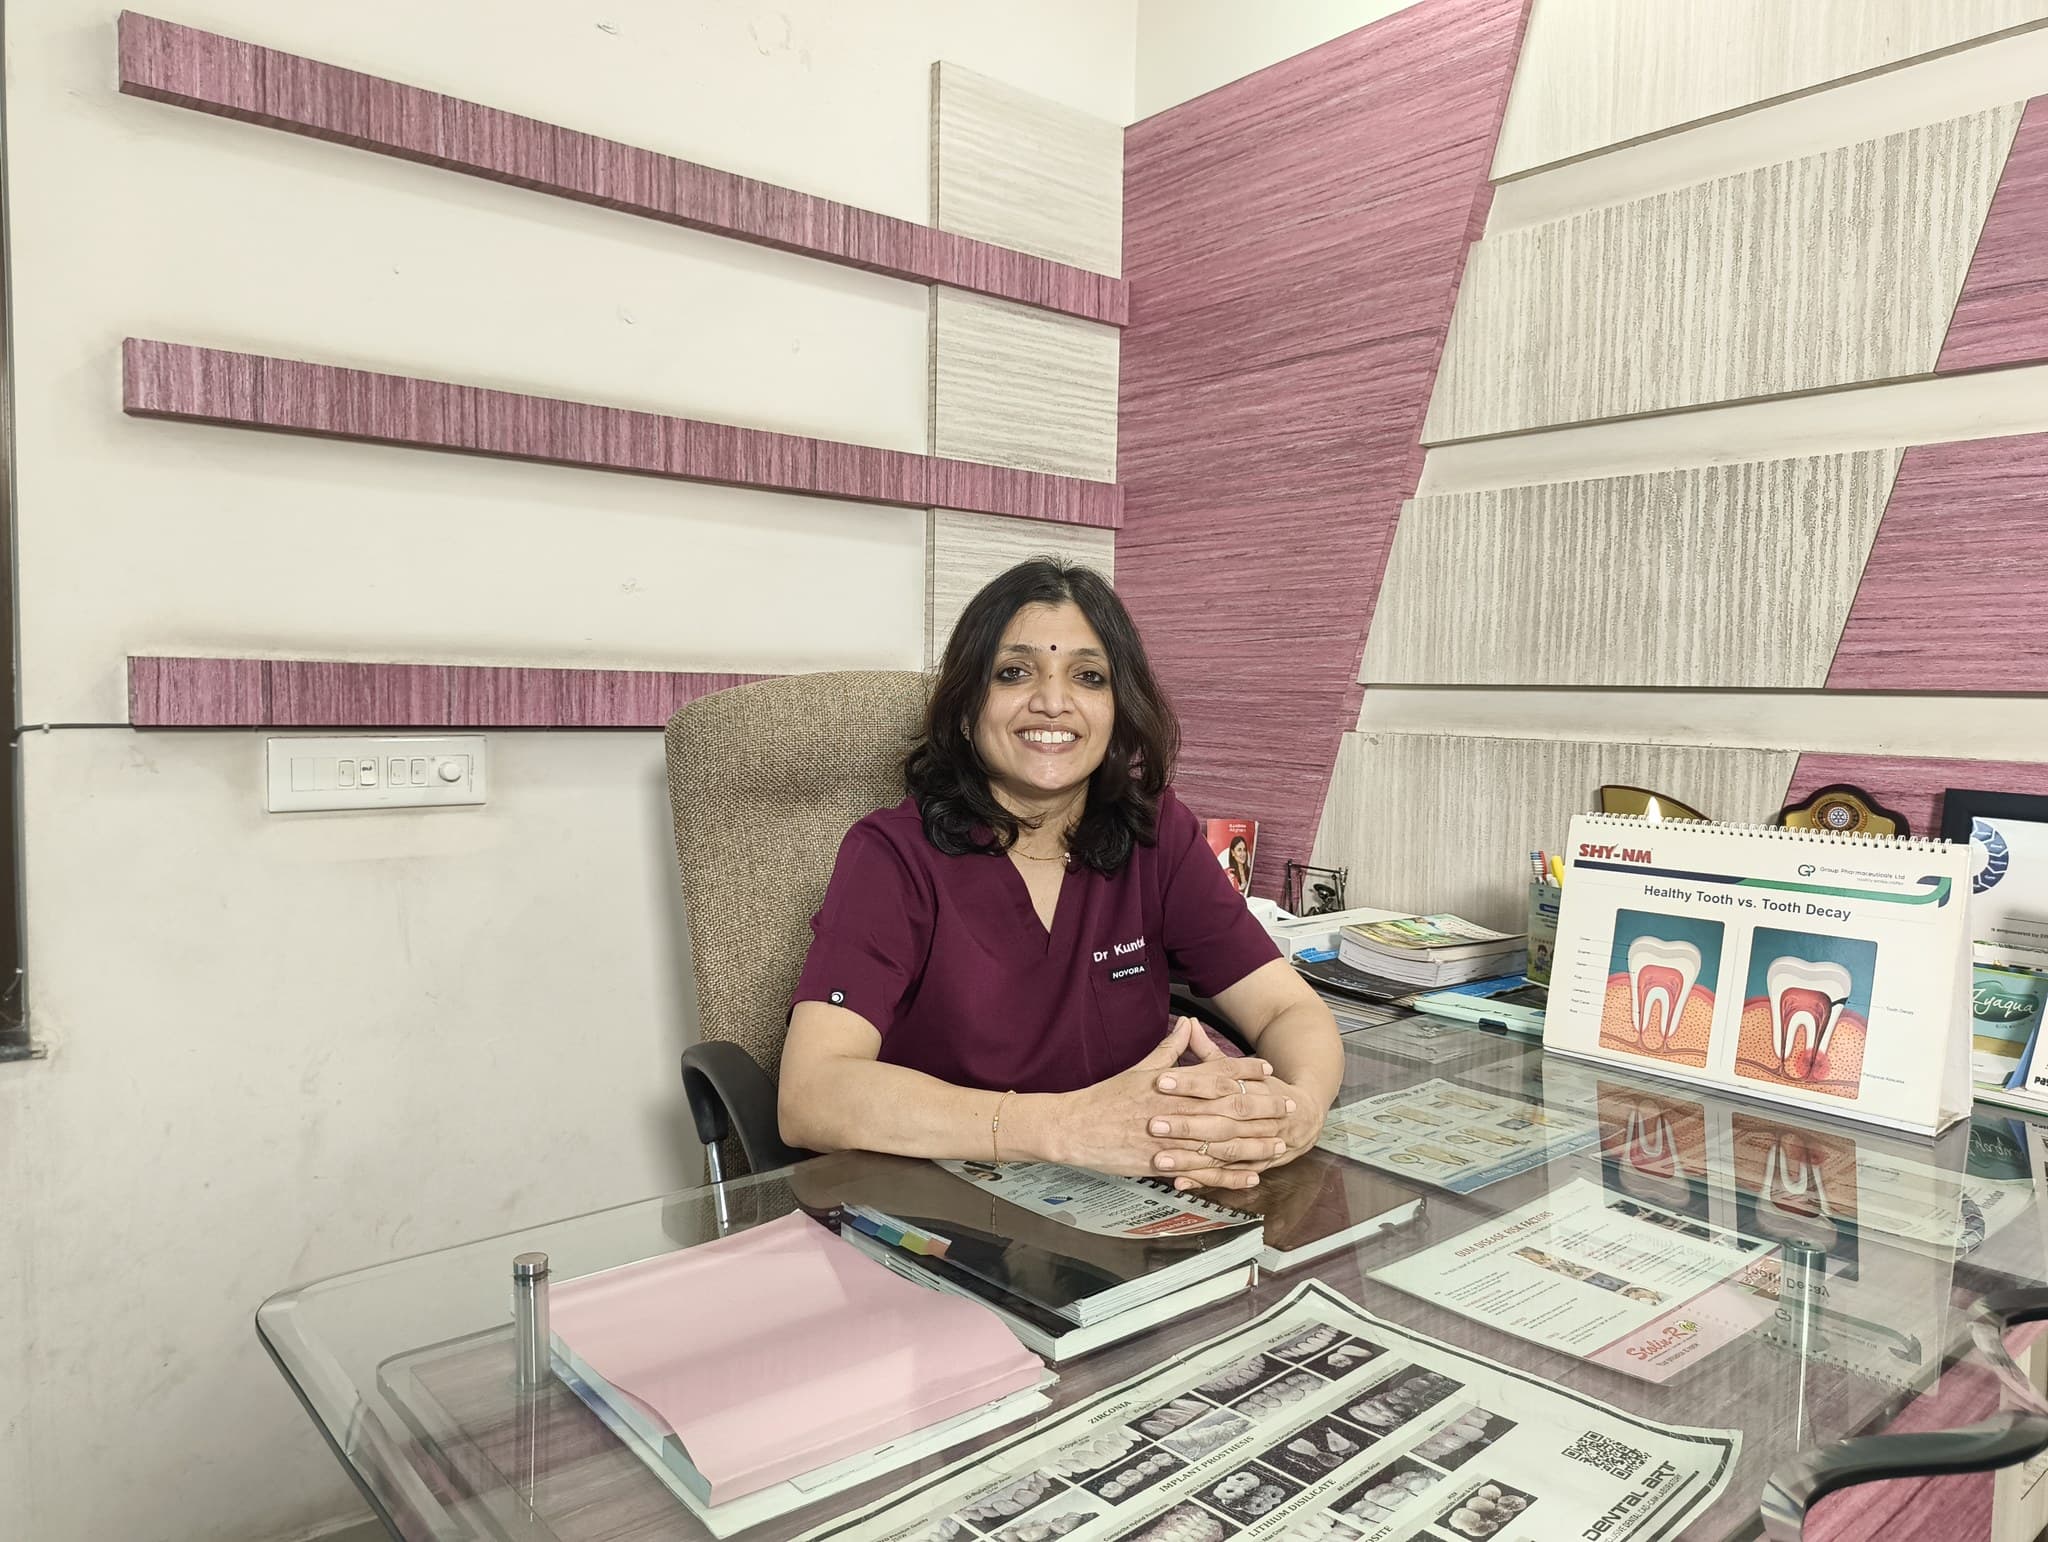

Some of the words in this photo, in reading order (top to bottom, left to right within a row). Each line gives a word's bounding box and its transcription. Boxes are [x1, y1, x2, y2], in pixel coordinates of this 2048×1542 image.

[1579, 843, 1653, 864] SHY-NM
[1820, 866, 1839, 874] Group
[1841, 868, 1893, 879] Pharmaceuticals
[1644, 885, 1692, 903] Healthy
[1696, 890, 1733, 905] Tooth
[1738, 898, 1757, 908] vs.
[1762, 898, 1801, 913] Tooth
[1806, 904, 1852, 921] Decay
[1093, 950, 1109, 962] Dr
[1112, 965, 1145, 979] NOVORA
[1972, 988, 2036, 1018] Zyaqua
[1088, 1400, 1132, 1424] ZIRCONIA
[1159, 1466, 1202, 1492] IMPLANT
[1201, 1435, 1255, 1468] PROSTHESIS
[1248, 1509, 1290, 1537] LITHIUM
[1287, 1478, 1337, 1512] DISILICATE
